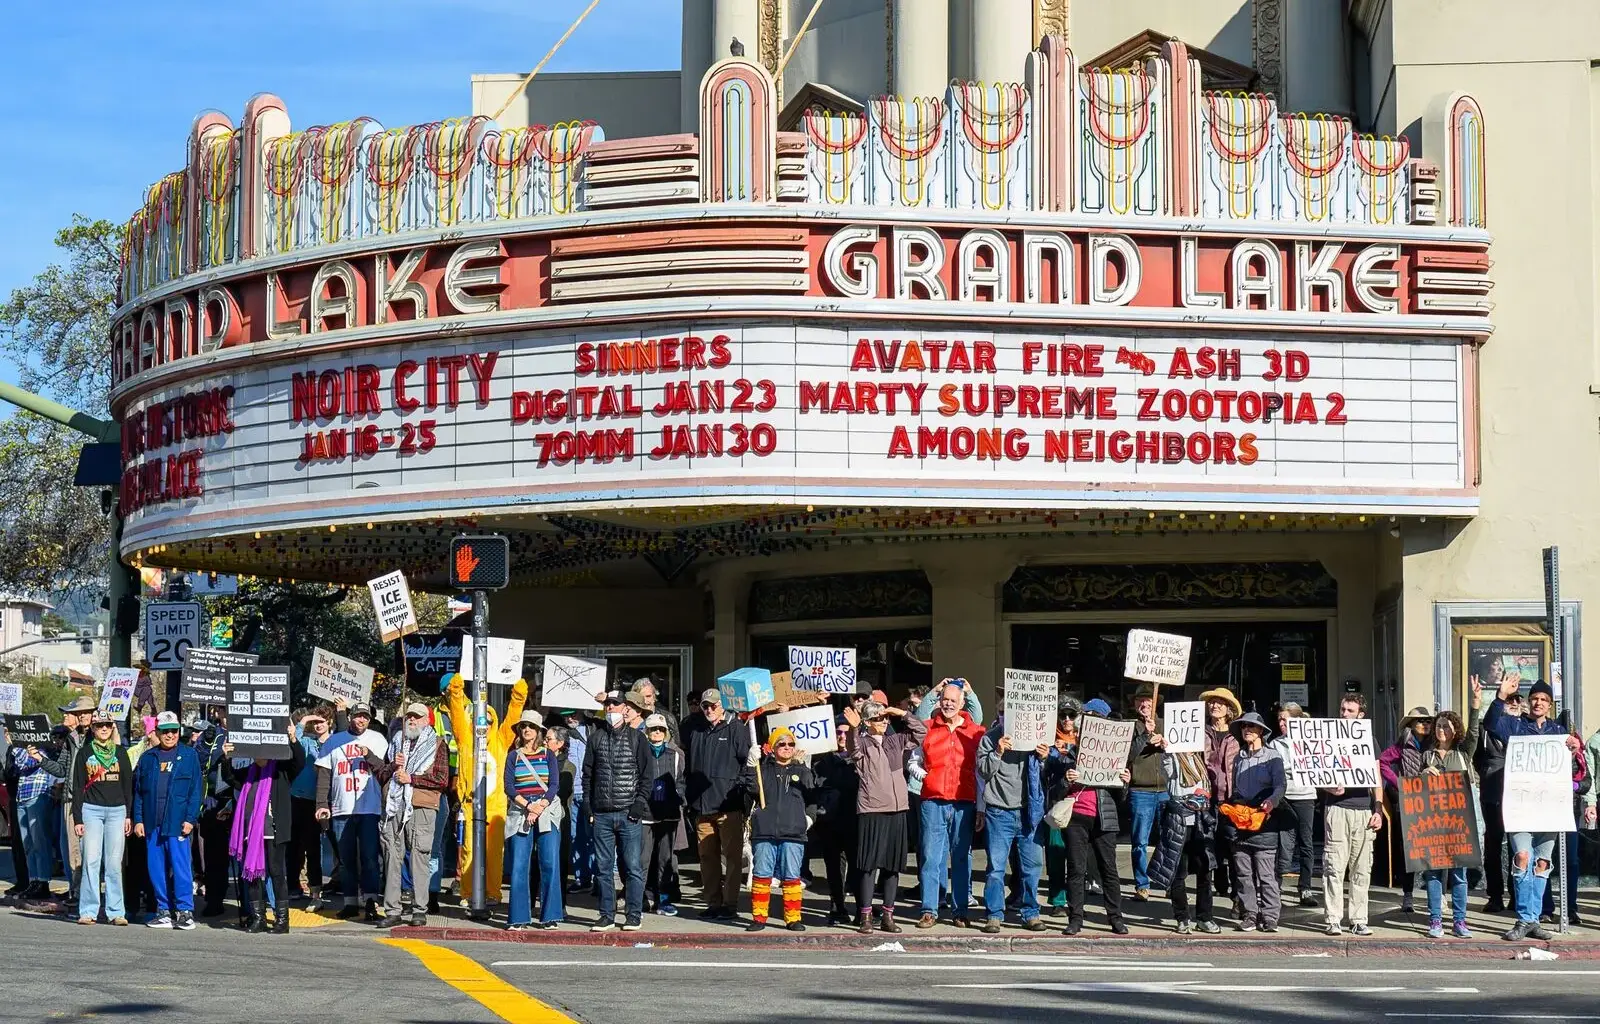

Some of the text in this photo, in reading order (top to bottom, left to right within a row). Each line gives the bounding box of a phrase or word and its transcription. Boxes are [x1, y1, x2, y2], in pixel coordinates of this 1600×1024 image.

[824, 223, 1402, 315] GRAND LAKE
[266, 240, 502, 341] LAKE
[576, 335, 732, 376] SINNERS
[850, 339, 997, 374] AVATAR
[1022, 341, 1105, 377] FIRE
[1168, 346, 1241, 382] ASH
[1262, 348, 1311, 382] 3D
[291, 350, 500, 424] NOIR CITY
[511, 378, 777, 425] DIGITAL JAN 23
[799, 381, 1348, 425] MARTY SUPREME ZOOTOPIA 2
[298, 420, 437, 465] JAN 16-25
[534, 422, 777, 467] 70MM JAN 30
[887, 425, 1259, 465] AMONG NEIGHBORS
[373, 575, 401, 591] RESIST
[380, 589, 402, 607] ICE
[151, 609, 195, 621] SPEED
[381, 603, 408, 617] IMPEACH
[384, 612, 409, 626] TRUMP
[155, 624, 191, 636] LIMIT
[1144, 635, 1154, 643] NO
[152, 638, 194, 663] 20
[790, 647, 852, 668] COURAGE
[318, 653, 358, 679] The Only Thing
[414, 660, 456, 672] CAFE
[1136, 653, 1149, 664] NO
[1151, 655, 1166, 666] ICE
[317, 665, 332, 679] ICE
[811, 666, 825, 676] IS
[1006, 671, 1056, 684] NO ONE VOTED
[1136, 665, 1148, 676] NO
[231, 674, 287, 684] WHY PROTEST?
[1012, 682, 1026, 691] FOR
[1029, 684, 1045, 693] WAR
[235, 692, 281, 701] IT'S EASIER
[727, 696, 746, 711] ICE
[1007, 691, 1019, 701] FOR
[1043, 694, 1057, 703] MEN
[105, 703, 125, 713] IKEA
[229, 705, 250, 713] THAN
[253, 706, 281, 714] HIDING
[1015, 702, 1026, 711] THE
[1027, 703, 1057, 712] STREETS
[1015, 712, 1047, 722] RISE UP
[1173, 708, 1199, 724] ICE
[14, 720, 36, 730] SAVE
[243, 720, 271, 728] FAMILY
[1014, 721, 1047, 731] RISE UP
[1084, 719, 1131, 738] IMPEACH
[1289, 719, 1366, 740] FIGHTING
[11, 731, 51, 743] DEMOCRACY
[229, 734, 239, 742] IN
[240, 735, 260, 743] YOUR
[1014, 731, 1047, 741] RISE UP
[1169, 727, 1200, 744] OUT
[1081, 736, 1131, 754] CONVICT
[1292, 739, 1371, 757] NAZIS is an
[1080, 752, 1125, 770] REMOVE
[1293, 755, 1352, 771] AMERICAN
[1511, 740, 1565, 774] END
[1083, 770, 1118, 783] NOW
[1296, 768, 1377, 786] TRADITION
[1402, 771, 1464, 794] NO HATE
[346, 777, 360, 792] DC
[1404, 791, 1466, 815] NO FEAR
[1412, 833, 1467, 848] IMMIGRANTS
[1409, 843, 1473, 860] ARE WELCOME
[1431, 855, 1455, 868] HERE
